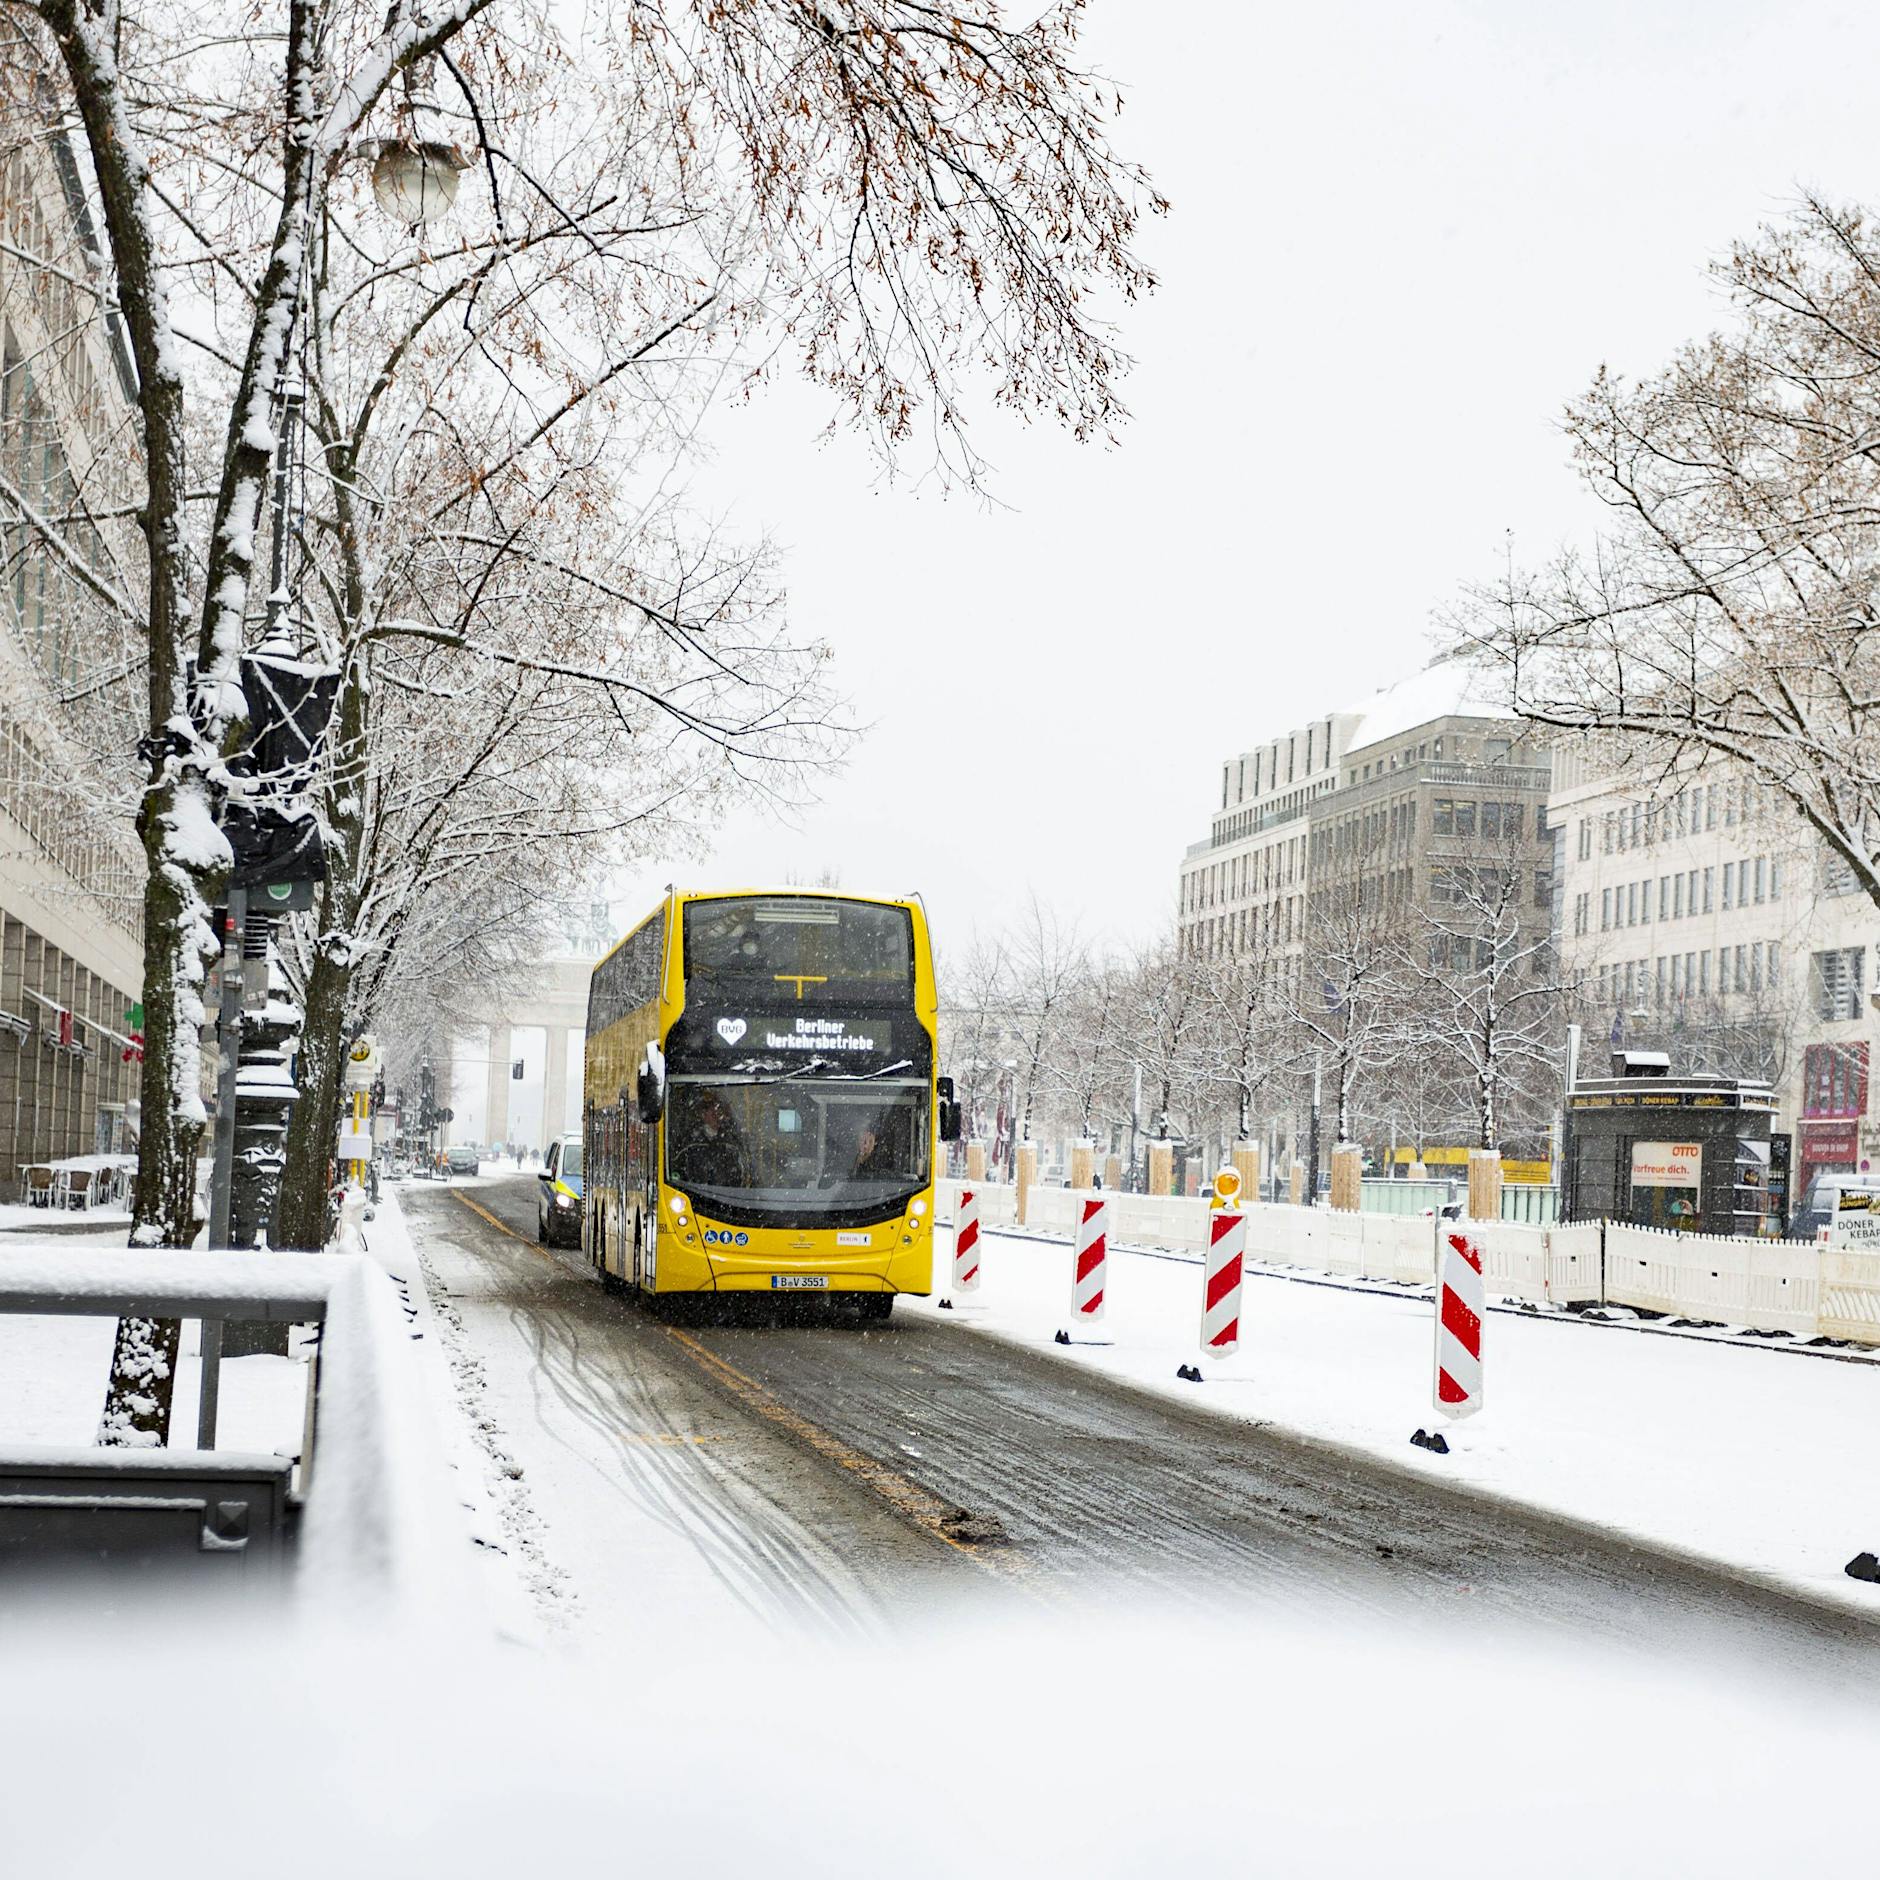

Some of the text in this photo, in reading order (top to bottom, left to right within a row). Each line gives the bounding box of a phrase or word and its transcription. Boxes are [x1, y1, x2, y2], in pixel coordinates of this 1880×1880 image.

[721, 1025, 743, 1034] BVG
[795, 1018, 846, 1034] Berliner
[766, 1033, 873, 1049] Verkehrsbetriebe
[1672, 1146, 1699, 1157] OTTO
[1667, 1164, 1690, 1174] dich.
[1838, 1219, 1874, 1230] DÖNER
[802, 1278, 824, 1286] 3551
